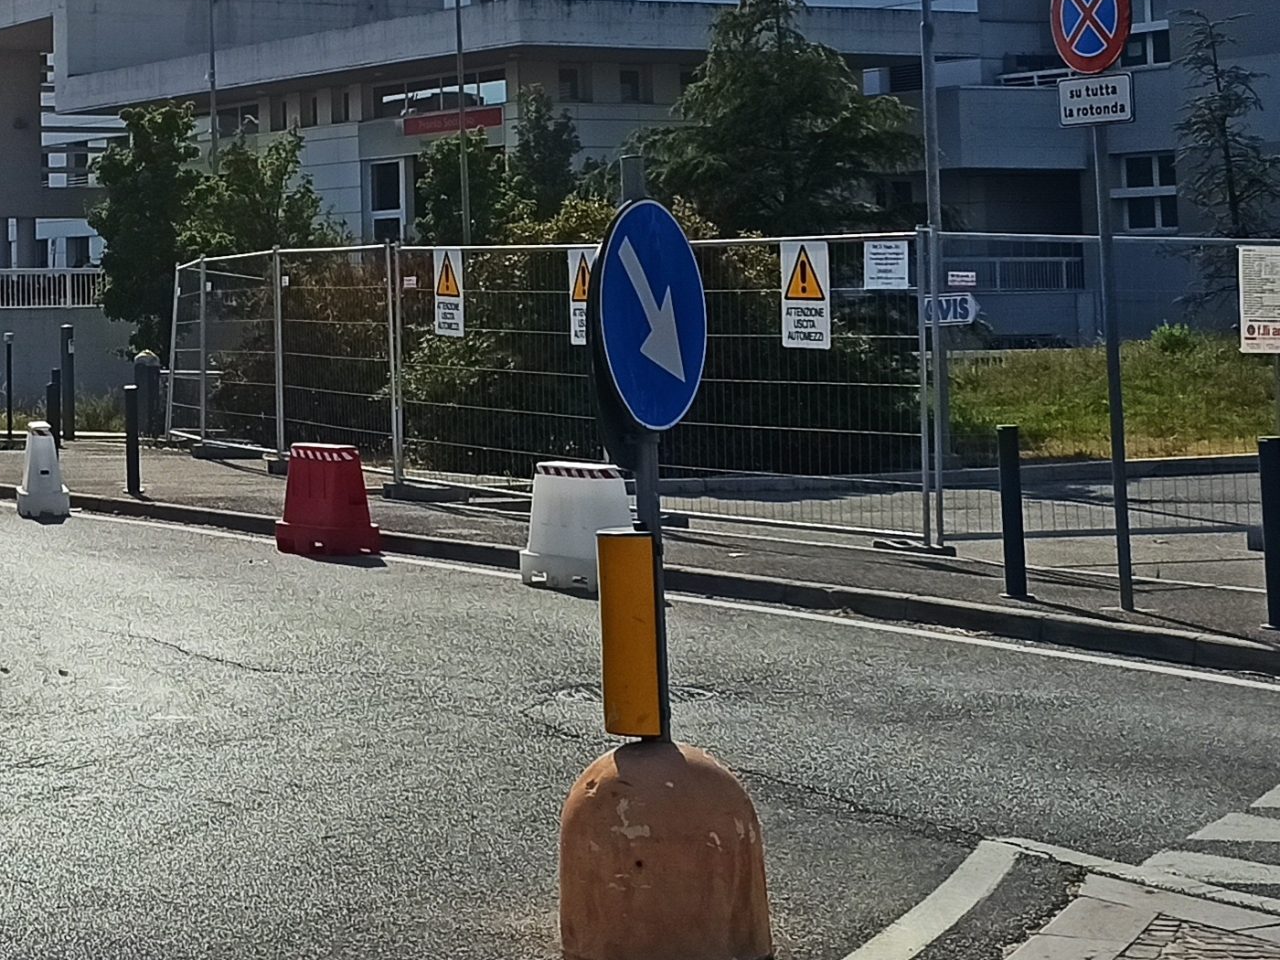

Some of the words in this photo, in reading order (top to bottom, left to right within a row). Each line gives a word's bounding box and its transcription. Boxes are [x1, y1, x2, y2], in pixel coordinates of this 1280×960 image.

[1069, 89, 1082, 99] su
[1085, 83, 1117, 97] tutta
[1064, 106, 1074, 118] la
[1077, 101, 1125, 117] rotonda
[786, 306, 824, 317] ATTENZIONE
[793, 318, 816, 329] USCITA
[788, 330, 824, 342] AUTOMEZZI
